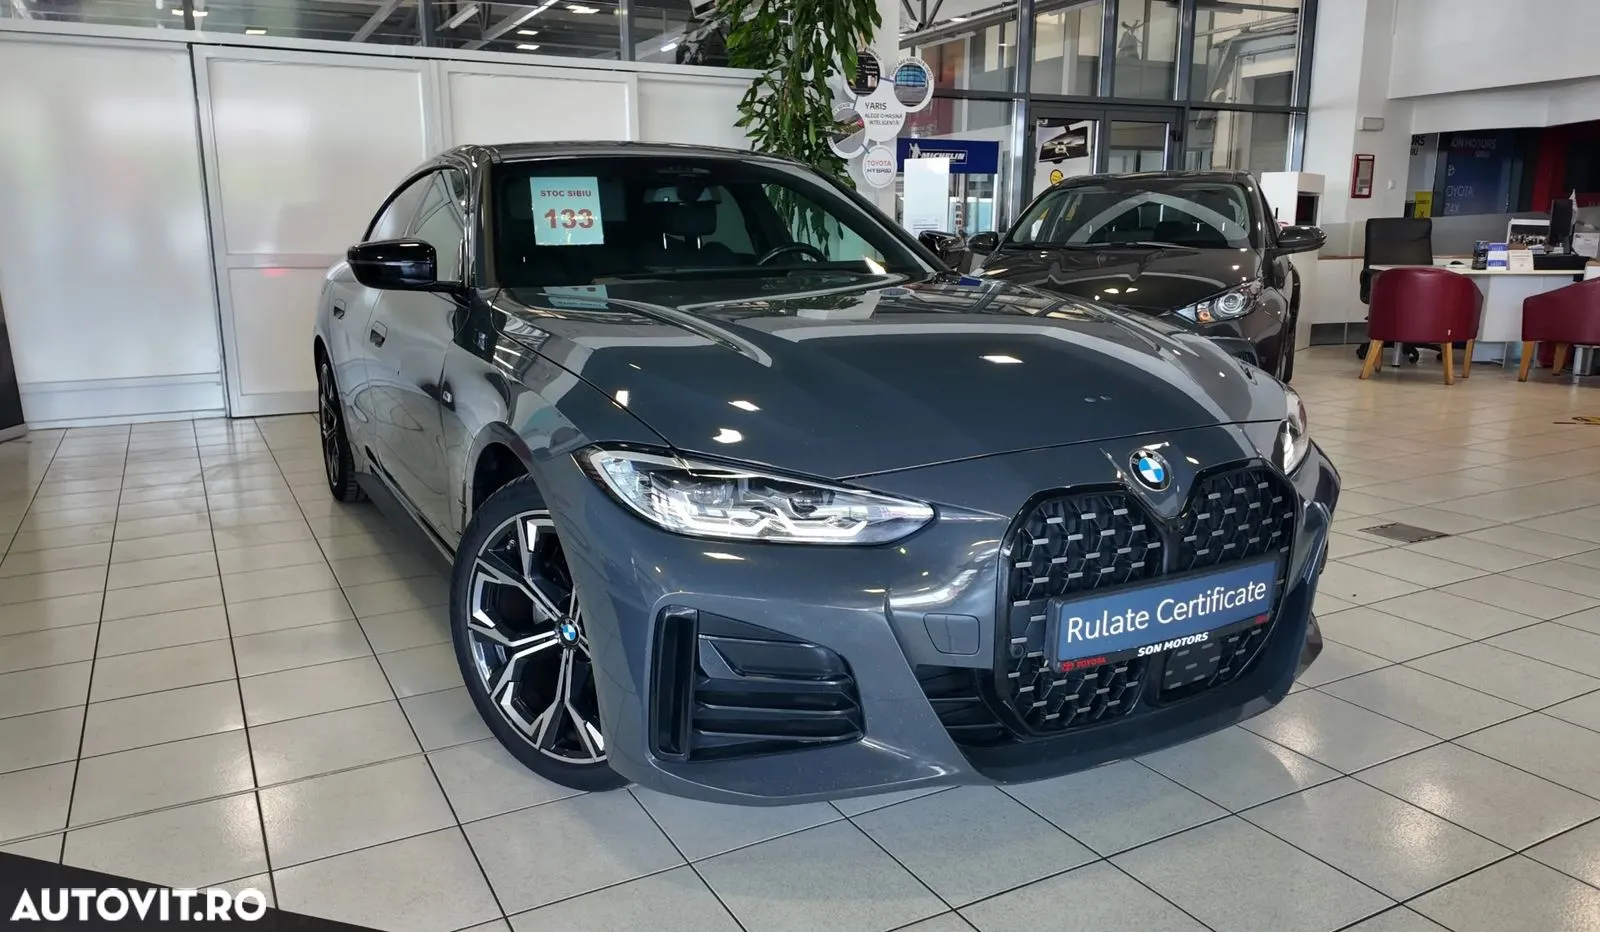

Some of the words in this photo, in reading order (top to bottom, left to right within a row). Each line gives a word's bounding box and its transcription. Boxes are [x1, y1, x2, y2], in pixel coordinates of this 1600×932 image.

[865, 102, 887, 110] YARIS
[920, 152, 966, 160] MICHELIN
[544, 208, 594, 229] 133
[1067, 608, 1150, 643] Rulate
[1156, 581, 1267, 624] Certificate
[1137, 643, 1163, 657] SON
[1163, 631, 1210, 652] MOTORS
